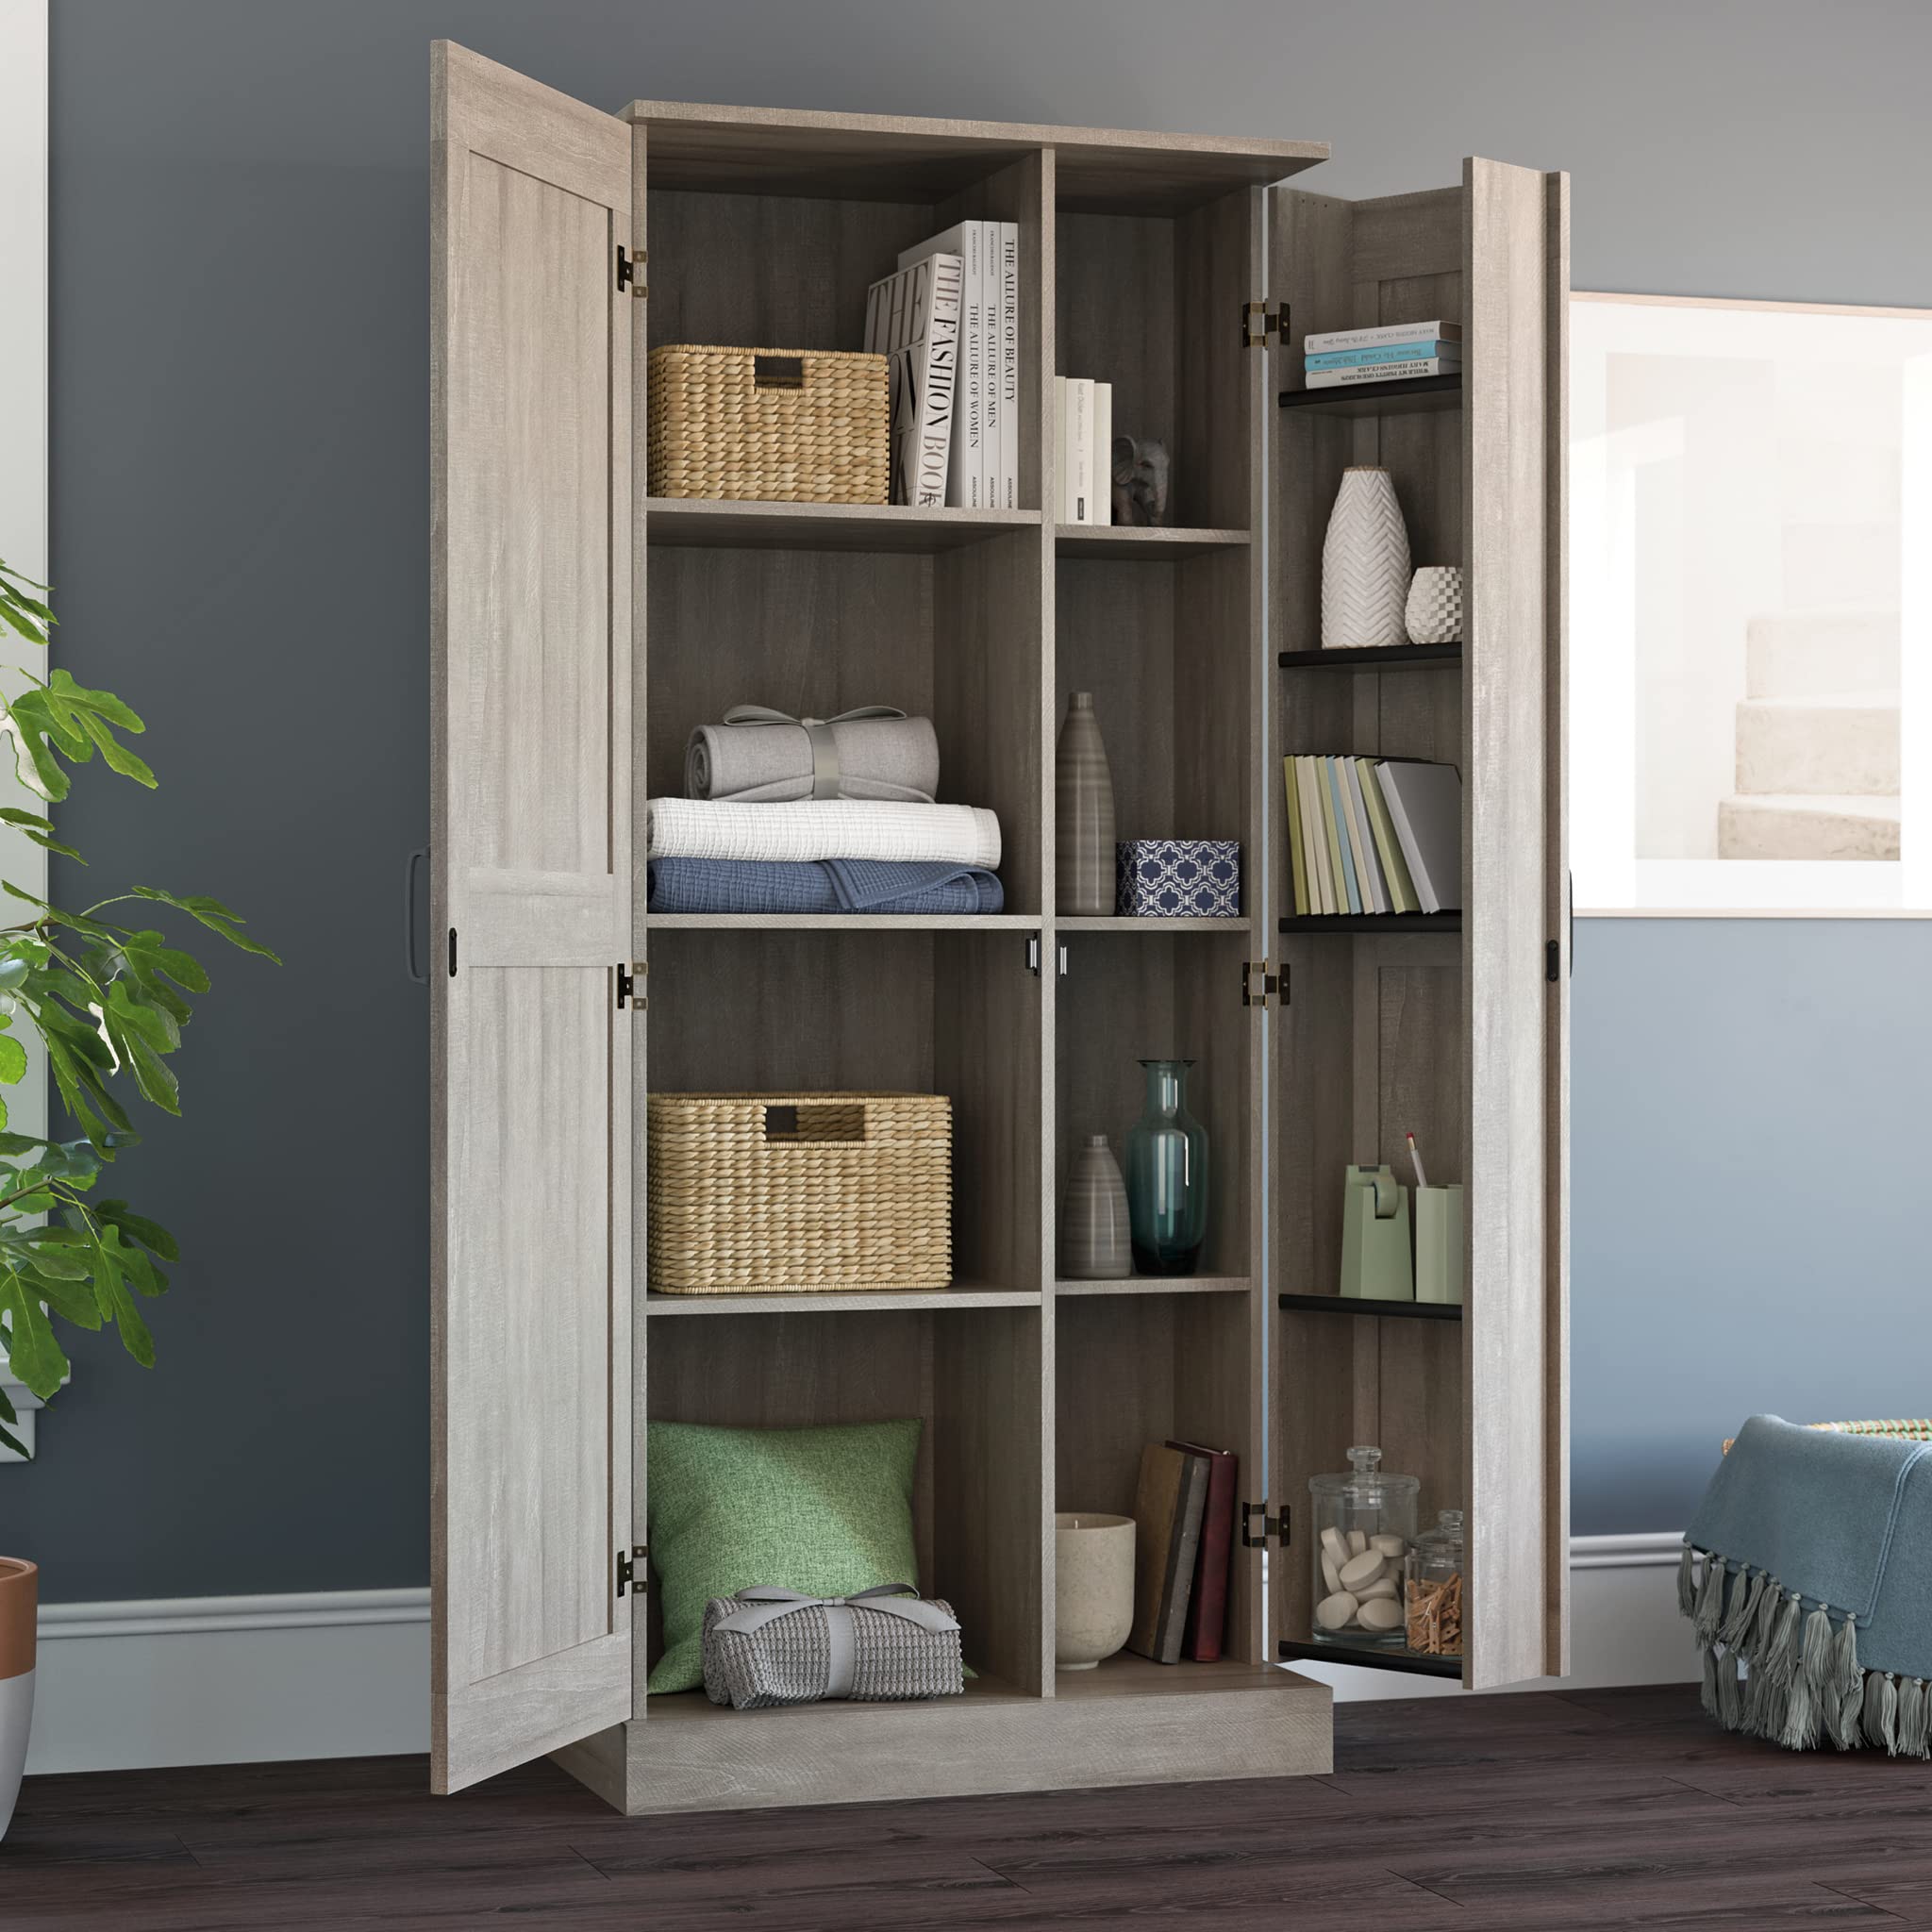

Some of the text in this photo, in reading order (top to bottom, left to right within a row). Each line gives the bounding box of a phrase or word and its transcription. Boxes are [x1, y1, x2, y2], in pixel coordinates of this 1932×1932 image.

[918, 259, 961, 507] THE FASHION BOOK
[970, 304, 979, 448] THE ALLURE OF WOMEN
[988, 305, 996, 428] THE ALLURE OF MEN
[1005, 239, 1015, 403] THE ALLURE OF BEAUTY
